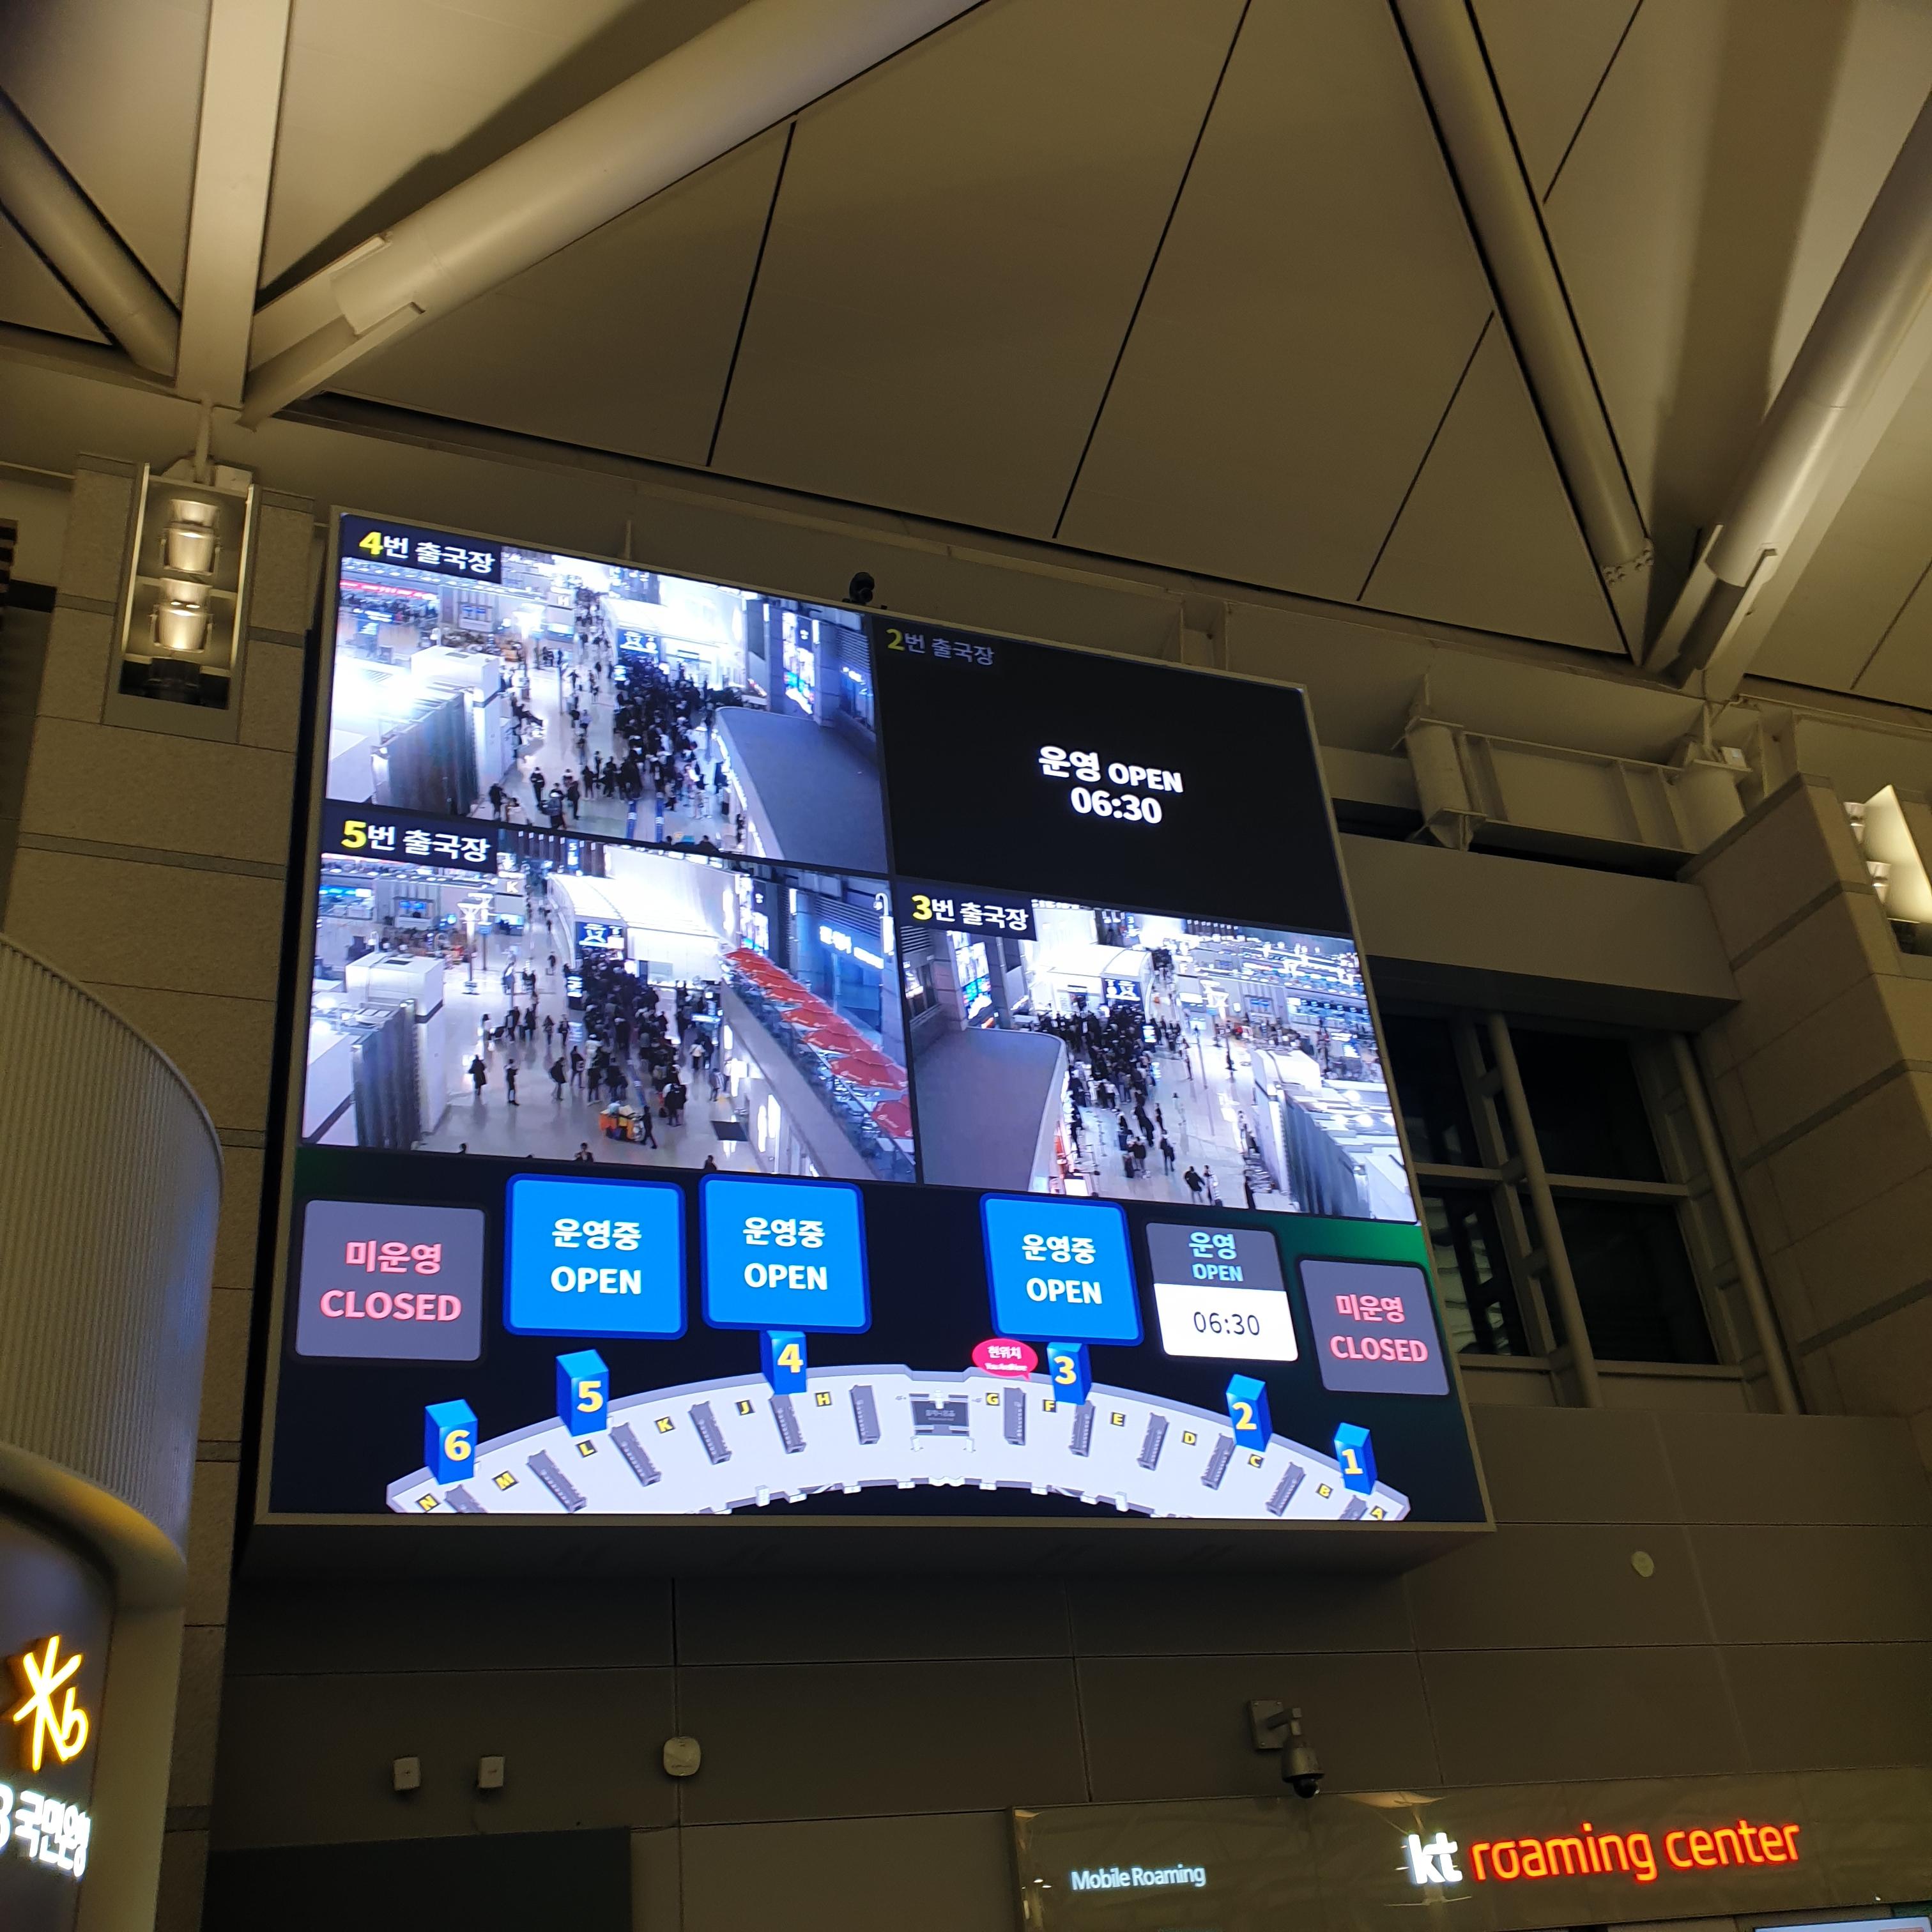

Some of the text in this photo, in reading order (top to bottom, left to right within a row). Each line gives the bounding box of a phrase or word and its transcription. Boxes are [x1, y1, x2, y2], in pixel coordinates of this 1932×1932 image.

[359, 532, 494, 574] 4번 출국장
[886, 629, 995, 666] 2번 출국장
[1039, 745, 1184, 793] 운영 OPEN
[1070, 787, 1163, 824] 06:30
[341, 820, 491, 862] 5번 출국장
[911, 894, 1029, 931] 3번 출국장
[551, 1218, 642, 1251] 운영중
[742, 1216, 825, 1248] 운영중
[1188, 1230, 1236, 1261] 운영
[346, 1239, 442, 1275] 미운영
[1022, 1233, 1096, 1265] 운영중
[550, 1266, 642, 1295] OPEN
[744, 1262, 828, 1291] OPEN
[1192, 1262, 1243, 1282] OPEN
[320, 1289, 462, 1322] CLOSED
[1025, 1277, 1102, 1305] OPEN
[1335, 1293, 1405, 1324] 미운영
[1193, 1310, 1261, 1337] 06:30
[777, 1344, 804, 1374] 4
[1330, 1335, 1429, 1363] CLOSED
[1053, 1355, 1077, 1385] 3
[577, 1380, 604, 1413] 5
[816, 1393, 830, 1405] H
[986, 1393, 999, 1406] G
[1045, 1400, 1054, 1411] F
[656, 1417, 673, 1432] K
[1114, 1414, 1123, 1425] E
[1232, 1402, 1257, 1430] 2
[444, 1429, 471, 1461] 6
[579, 1443, 594, 1455] L
[1184, 1432, 1195, 1445] D
[1250, 1455, 1261, 1467] C
[1342, 1448, 1363, 1475] 1
[496, 1473, 516, 1489] M
[1319, 1485, 1331, 1498] B
[419, 1496, 438, 1510] N
[1370, 1508, 1384, 1519] A
[1407, 1818, 1800, 1885] kt roaming center
[1071, 1864, 1206, 1891] Mobile Roaming
